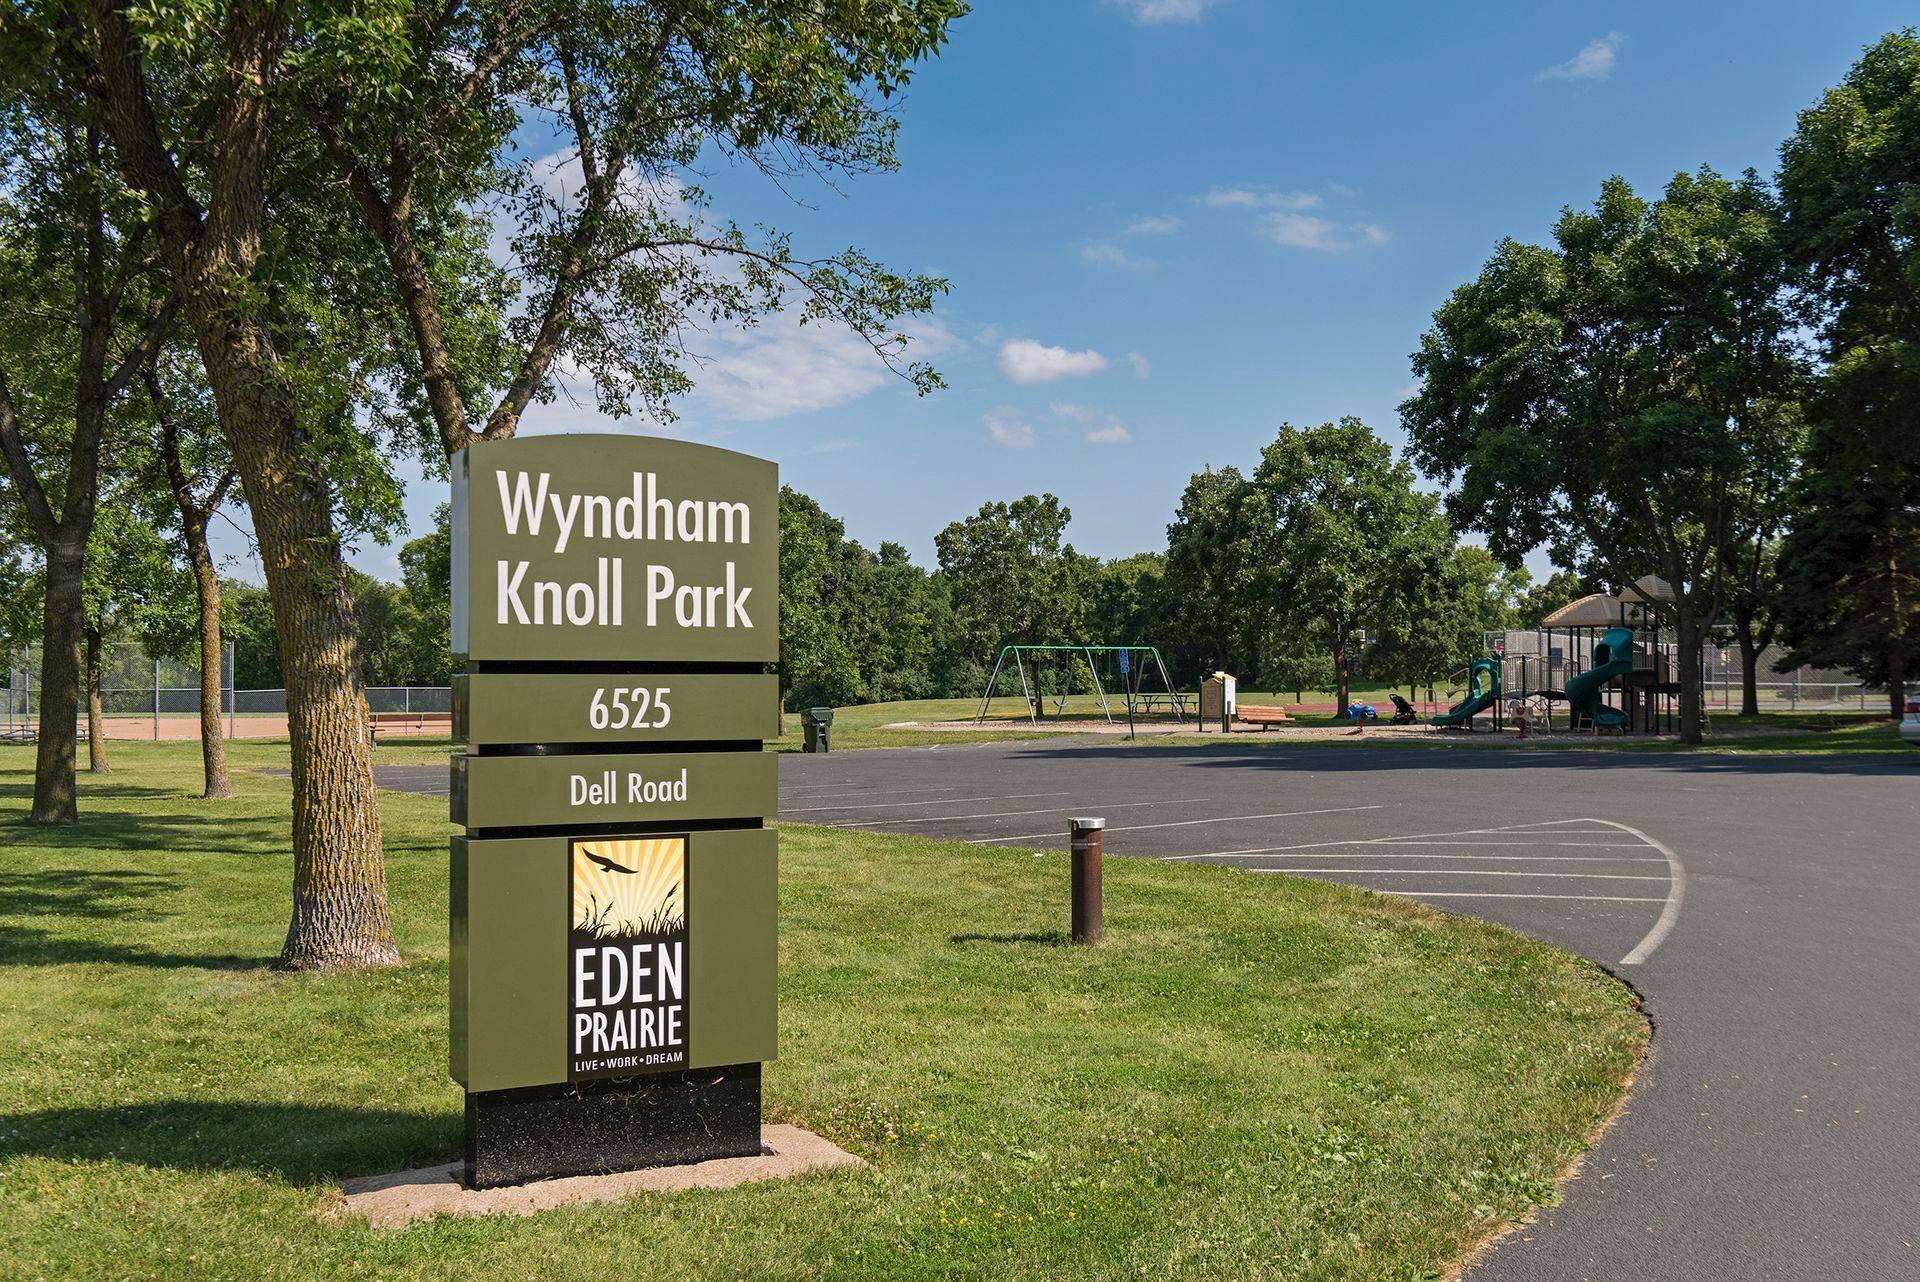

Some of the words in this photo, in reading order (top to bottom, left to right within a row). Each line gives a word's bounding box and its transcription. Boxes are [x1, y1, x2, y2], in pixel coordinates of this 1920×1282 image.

[496, 470, 750, 553] Wyndham
[497, 557, 622, 626] Knoll
[647, 562, 754, 628] Park
[589, 687, 671, 729] 6525
[570, 771, 617, 805] Dell
[628, 768, 687, 803] Road
[575, 942, 682, 1008] EDEN
[575, 1005, 682, 1055] PRAIRIE
[575, 1060, 598, 1072] LIVE
[606, 1056, 638, 1069] WORK
[645, 1052, 683, 1065] DREAM
